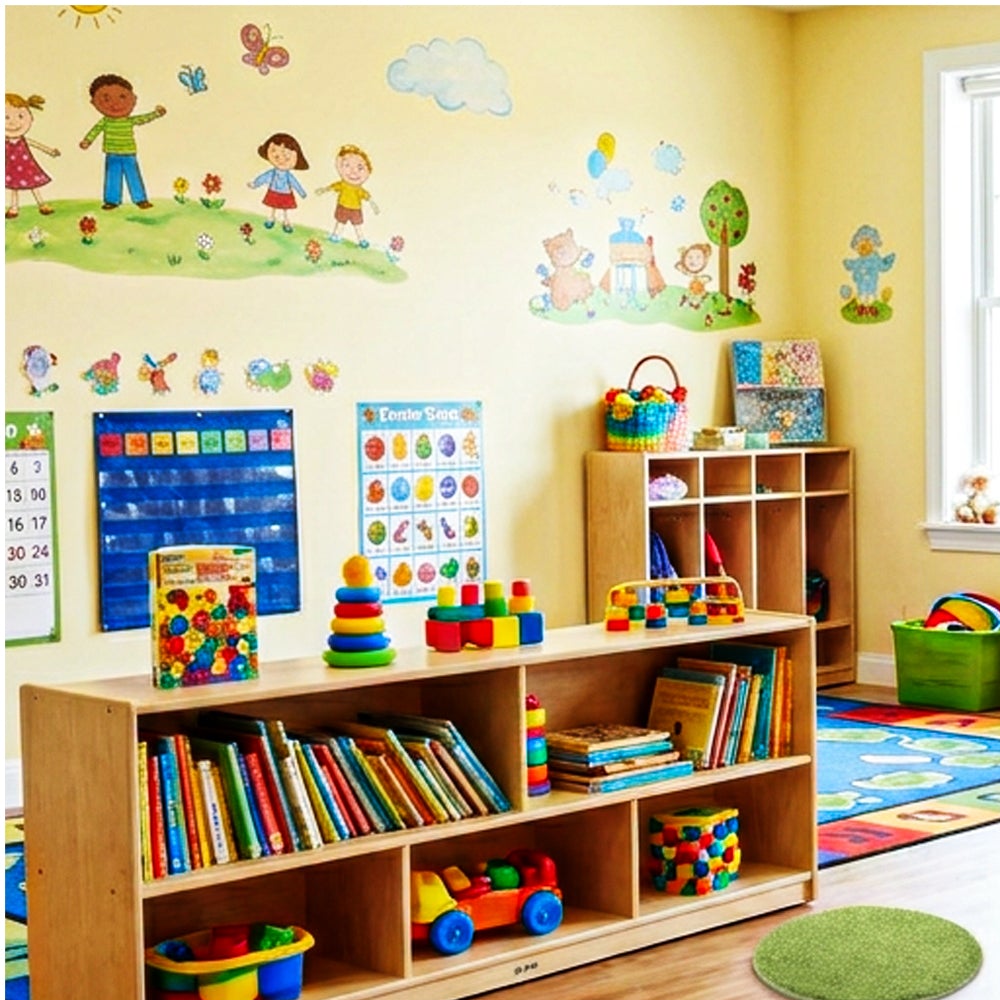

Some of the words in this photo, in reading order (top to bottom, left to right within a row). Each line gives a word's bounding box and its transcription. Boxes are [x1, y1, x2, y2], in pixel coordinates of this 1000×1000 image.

[10, 460, 19, 476] 6
[33, 460, 42, 474] 3
[8, 516, 25, 532] 16
[32, 515, 48, 531] 17
[7, 545, 26, 562] 30
[32, 544, 49, 559] 24
[9, 574, 28, 590] 30
[34, 573, 50, 588] 31
